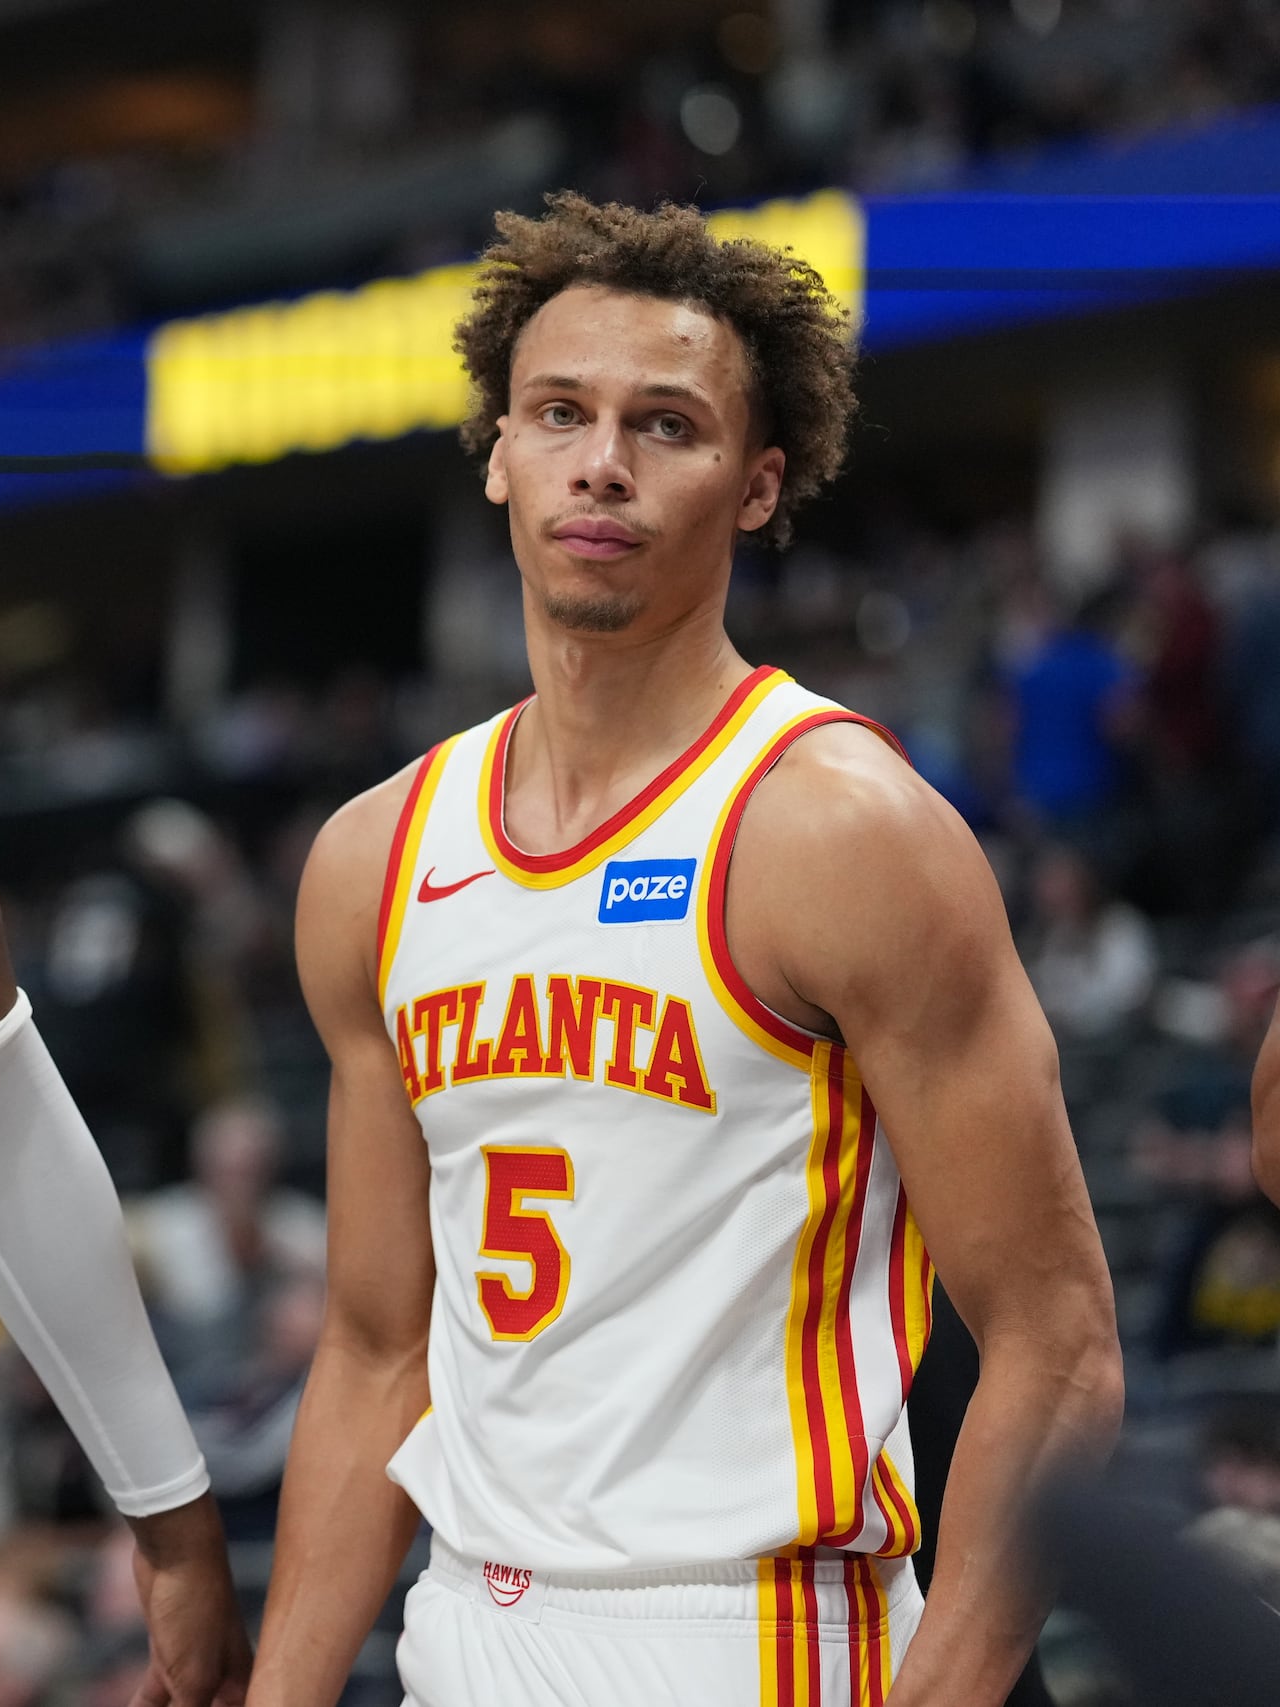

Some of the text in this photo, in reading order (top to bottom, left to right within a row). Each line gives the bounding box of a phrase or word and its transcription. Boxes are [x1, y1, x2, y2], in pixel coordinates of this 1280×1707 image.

[605, 869, 688, 908] paze
[395, 973, 717, 1116] ATLANTA
[474, 1145, 575, 1342] 5
[483, 1560, 532, 1590] HAWKS
